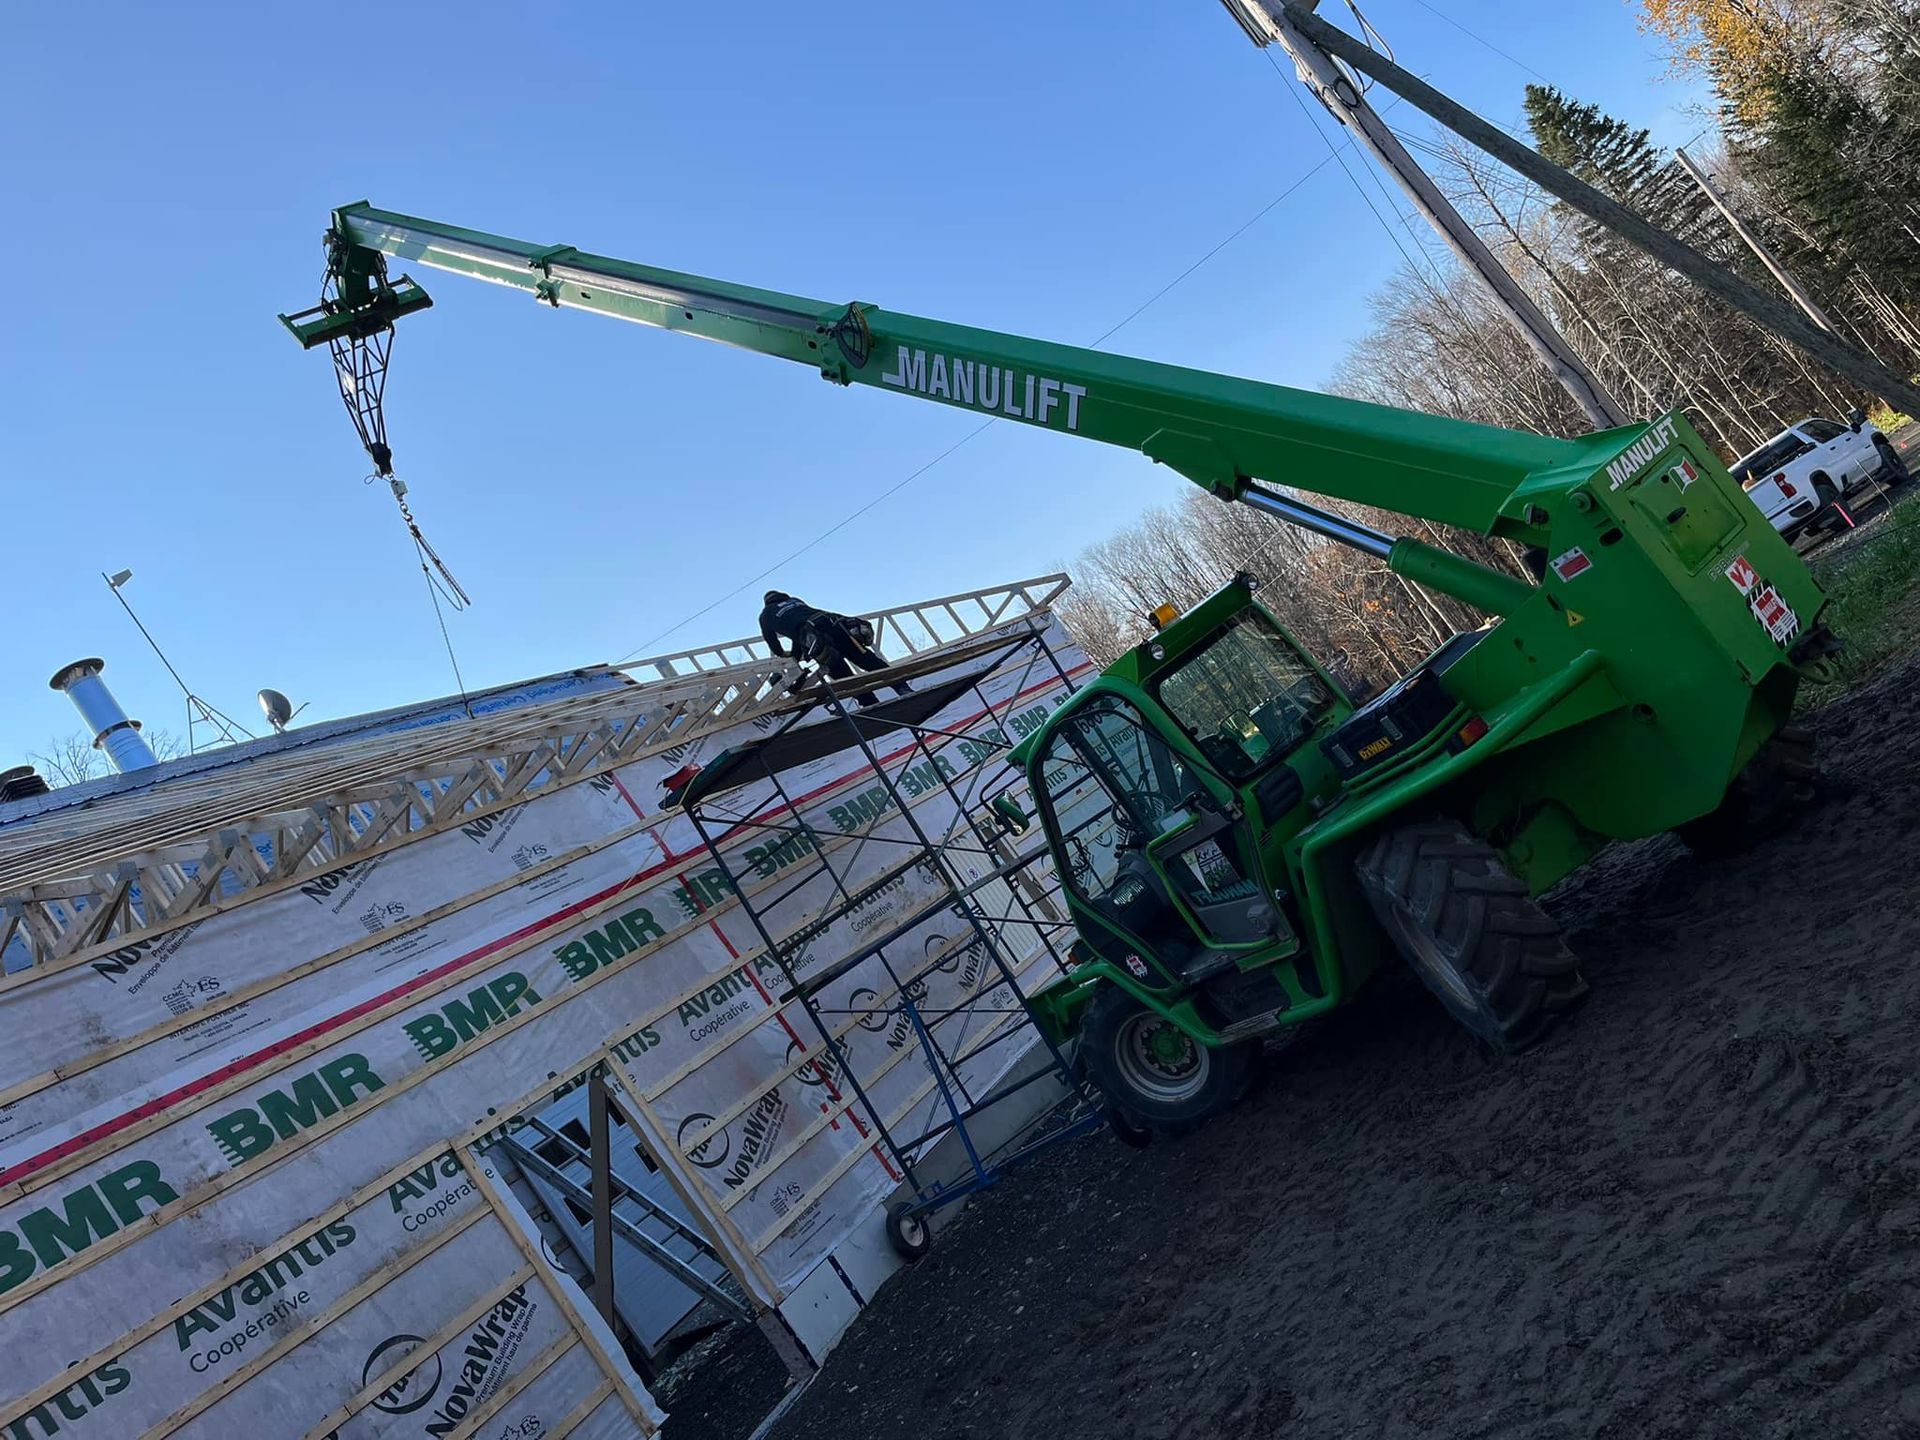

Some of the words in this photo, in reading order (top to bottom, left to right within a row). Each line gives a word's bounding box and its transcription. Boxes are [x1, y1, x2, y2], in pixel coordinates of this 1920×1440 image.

[881, 345, 1088, 430] MANULIFT
[1608, 416, 1679, 492] MANULIFT
[1009, 705, 1049, 739] BMR
[827, 786, 896, 832] BMR
[902, 755, 957, 798] BMR
[743, 823, 825, 880] BMR
[128, 962, 161, 995] Enveloppe
[553, 908, 666, 982] BMR
[162, 989, 184, 1003] CCMC
[198, 977, 220, 993] ES
[402, 972, 542, 1064] BMR
[690, 1001, 750, 1041] Coopérative
[207, 1053, 387, 1168] BMR
[723, 1087, 782, 1190] NovaWrap
[0, 1159, 180, 1294] BMR
[403, 1168, 495, 1232] Coopérate
[171, 1216, 356, 1352] Avantis
[190, 1289, 310, 1373] Coopérative
[425, 1284, 529, 1440] NovaWrap
[476, 1365, 499, 1404] Premium
[494, 1330, 516, 1365] Building
[511, 1308, 526, 1333] Wrap
[506, 1341, 519, 1361] haut
[515, 1331, 525, 1343] de
[521, 1303, 538, 1336] gamme
[520, 1416, 541, 1436] ES
